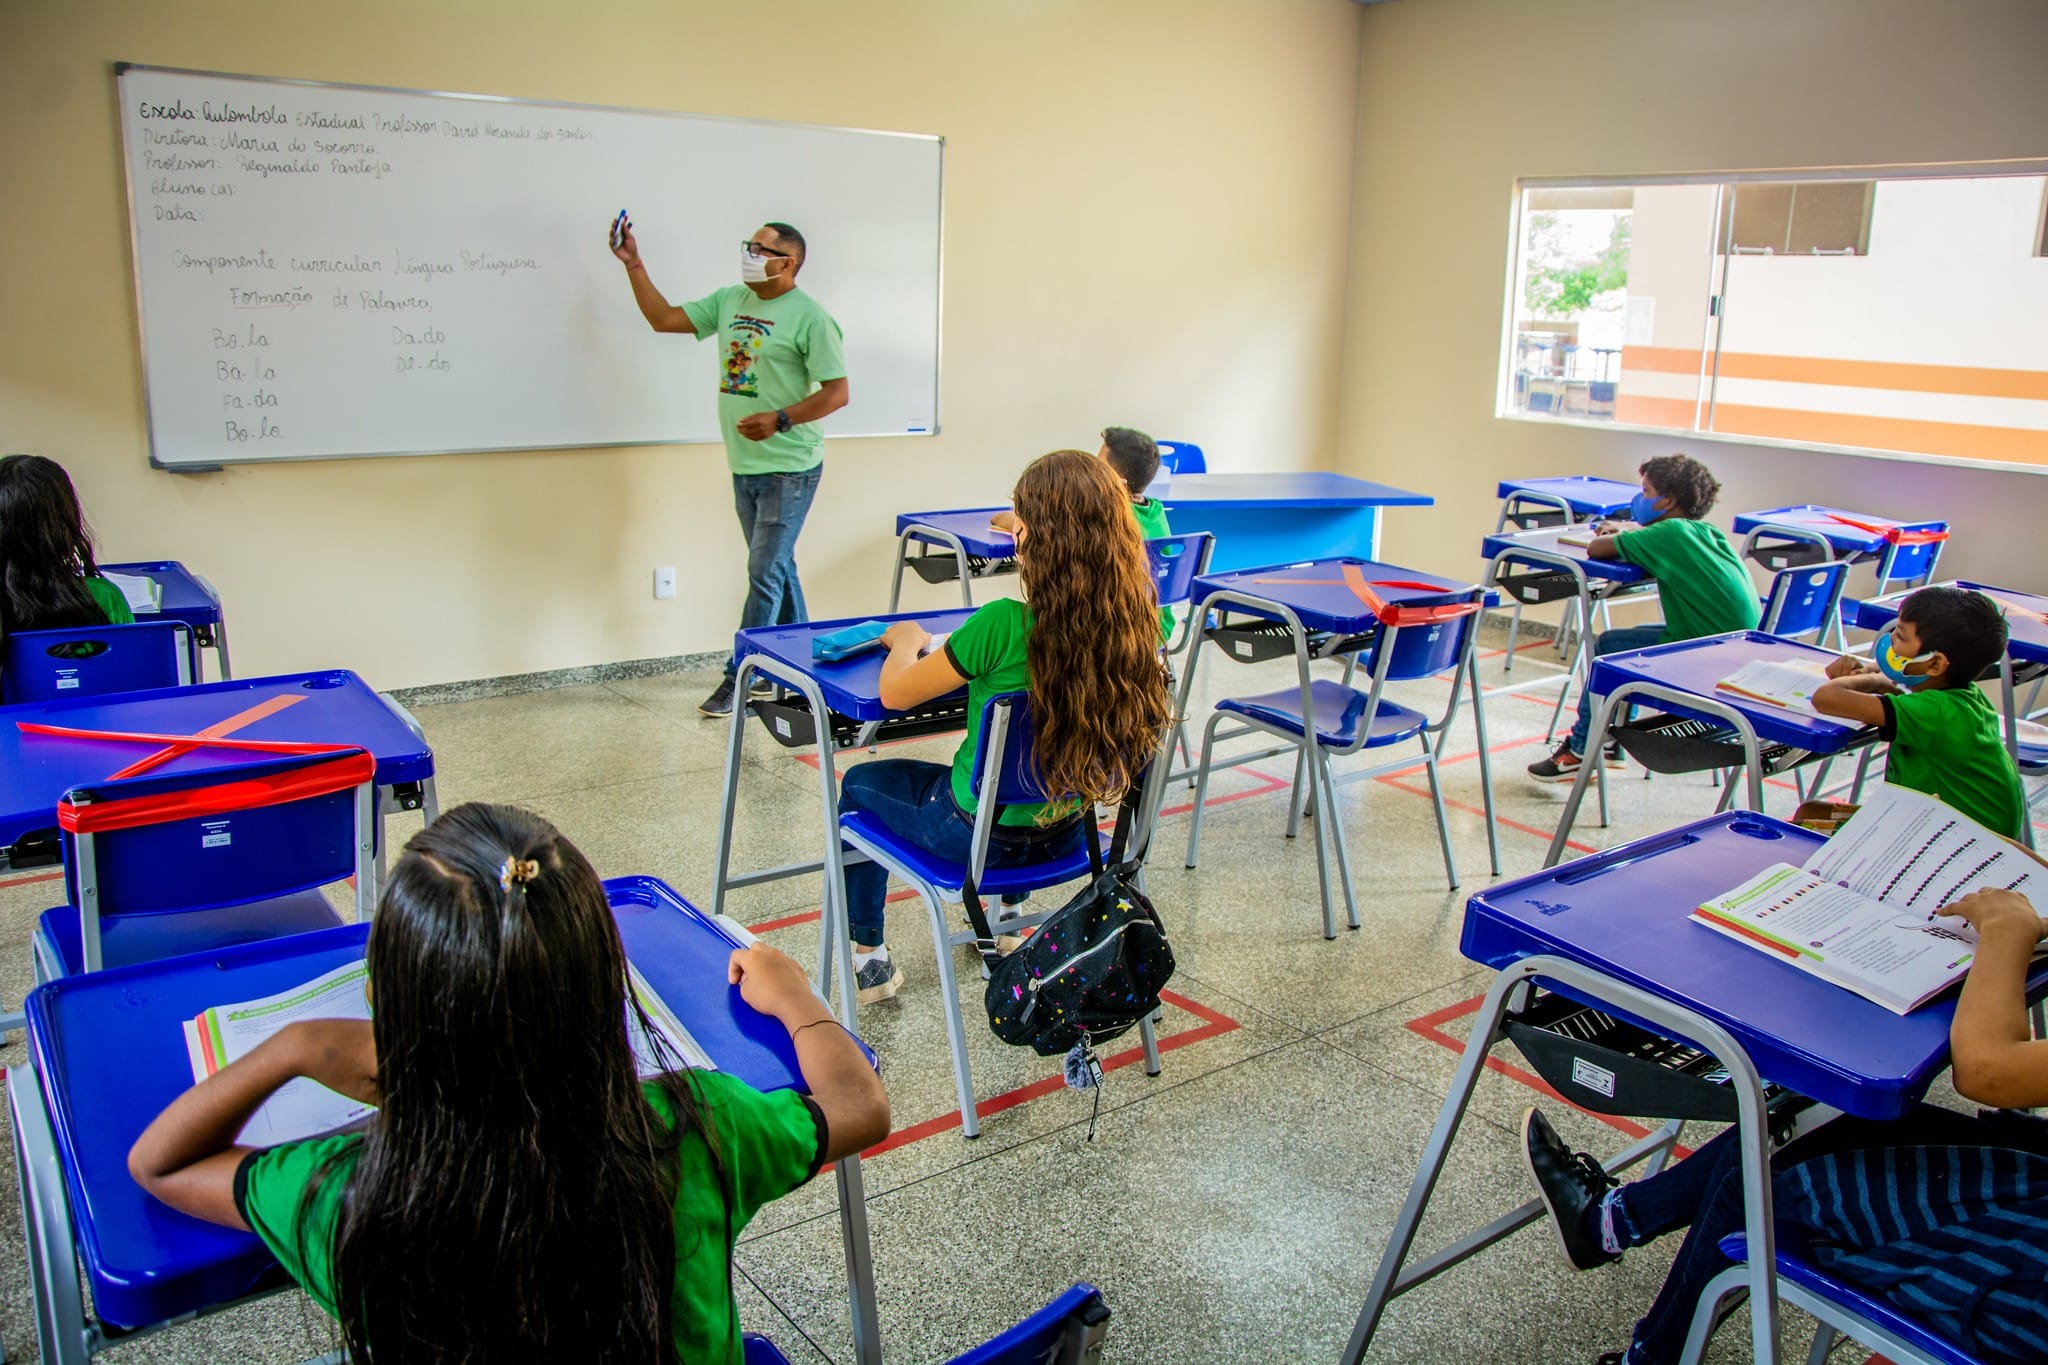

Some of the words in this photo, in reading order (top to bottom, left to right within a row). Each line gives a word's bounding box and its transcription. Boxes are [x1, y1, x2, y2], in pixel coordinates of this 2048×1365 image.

[139, 99, 199, 120] Escola:
[296, 111, 366, 130] Estadual
[372, 112, 437, 142] Professor
[442, 119, 480, 139] David
[143, 128, 217, 147] Diretora:
[220, 131, 279, 153] Maria
[288, 137, 307, 152] do
[143, 150, 222, 174] Professor:
[236, 153, 321, 178] Reginaldo
[330, 158, 392, 180] Pantoja
[153, 204, 204, 223] Data:
[170, 247, 278, 275] Componente
[290, 253, 383, 273] curricular
[393, 247, 455, 282] Língua
[229, 286, 314, 313] Formação
[331, 286, 350, 308] de
